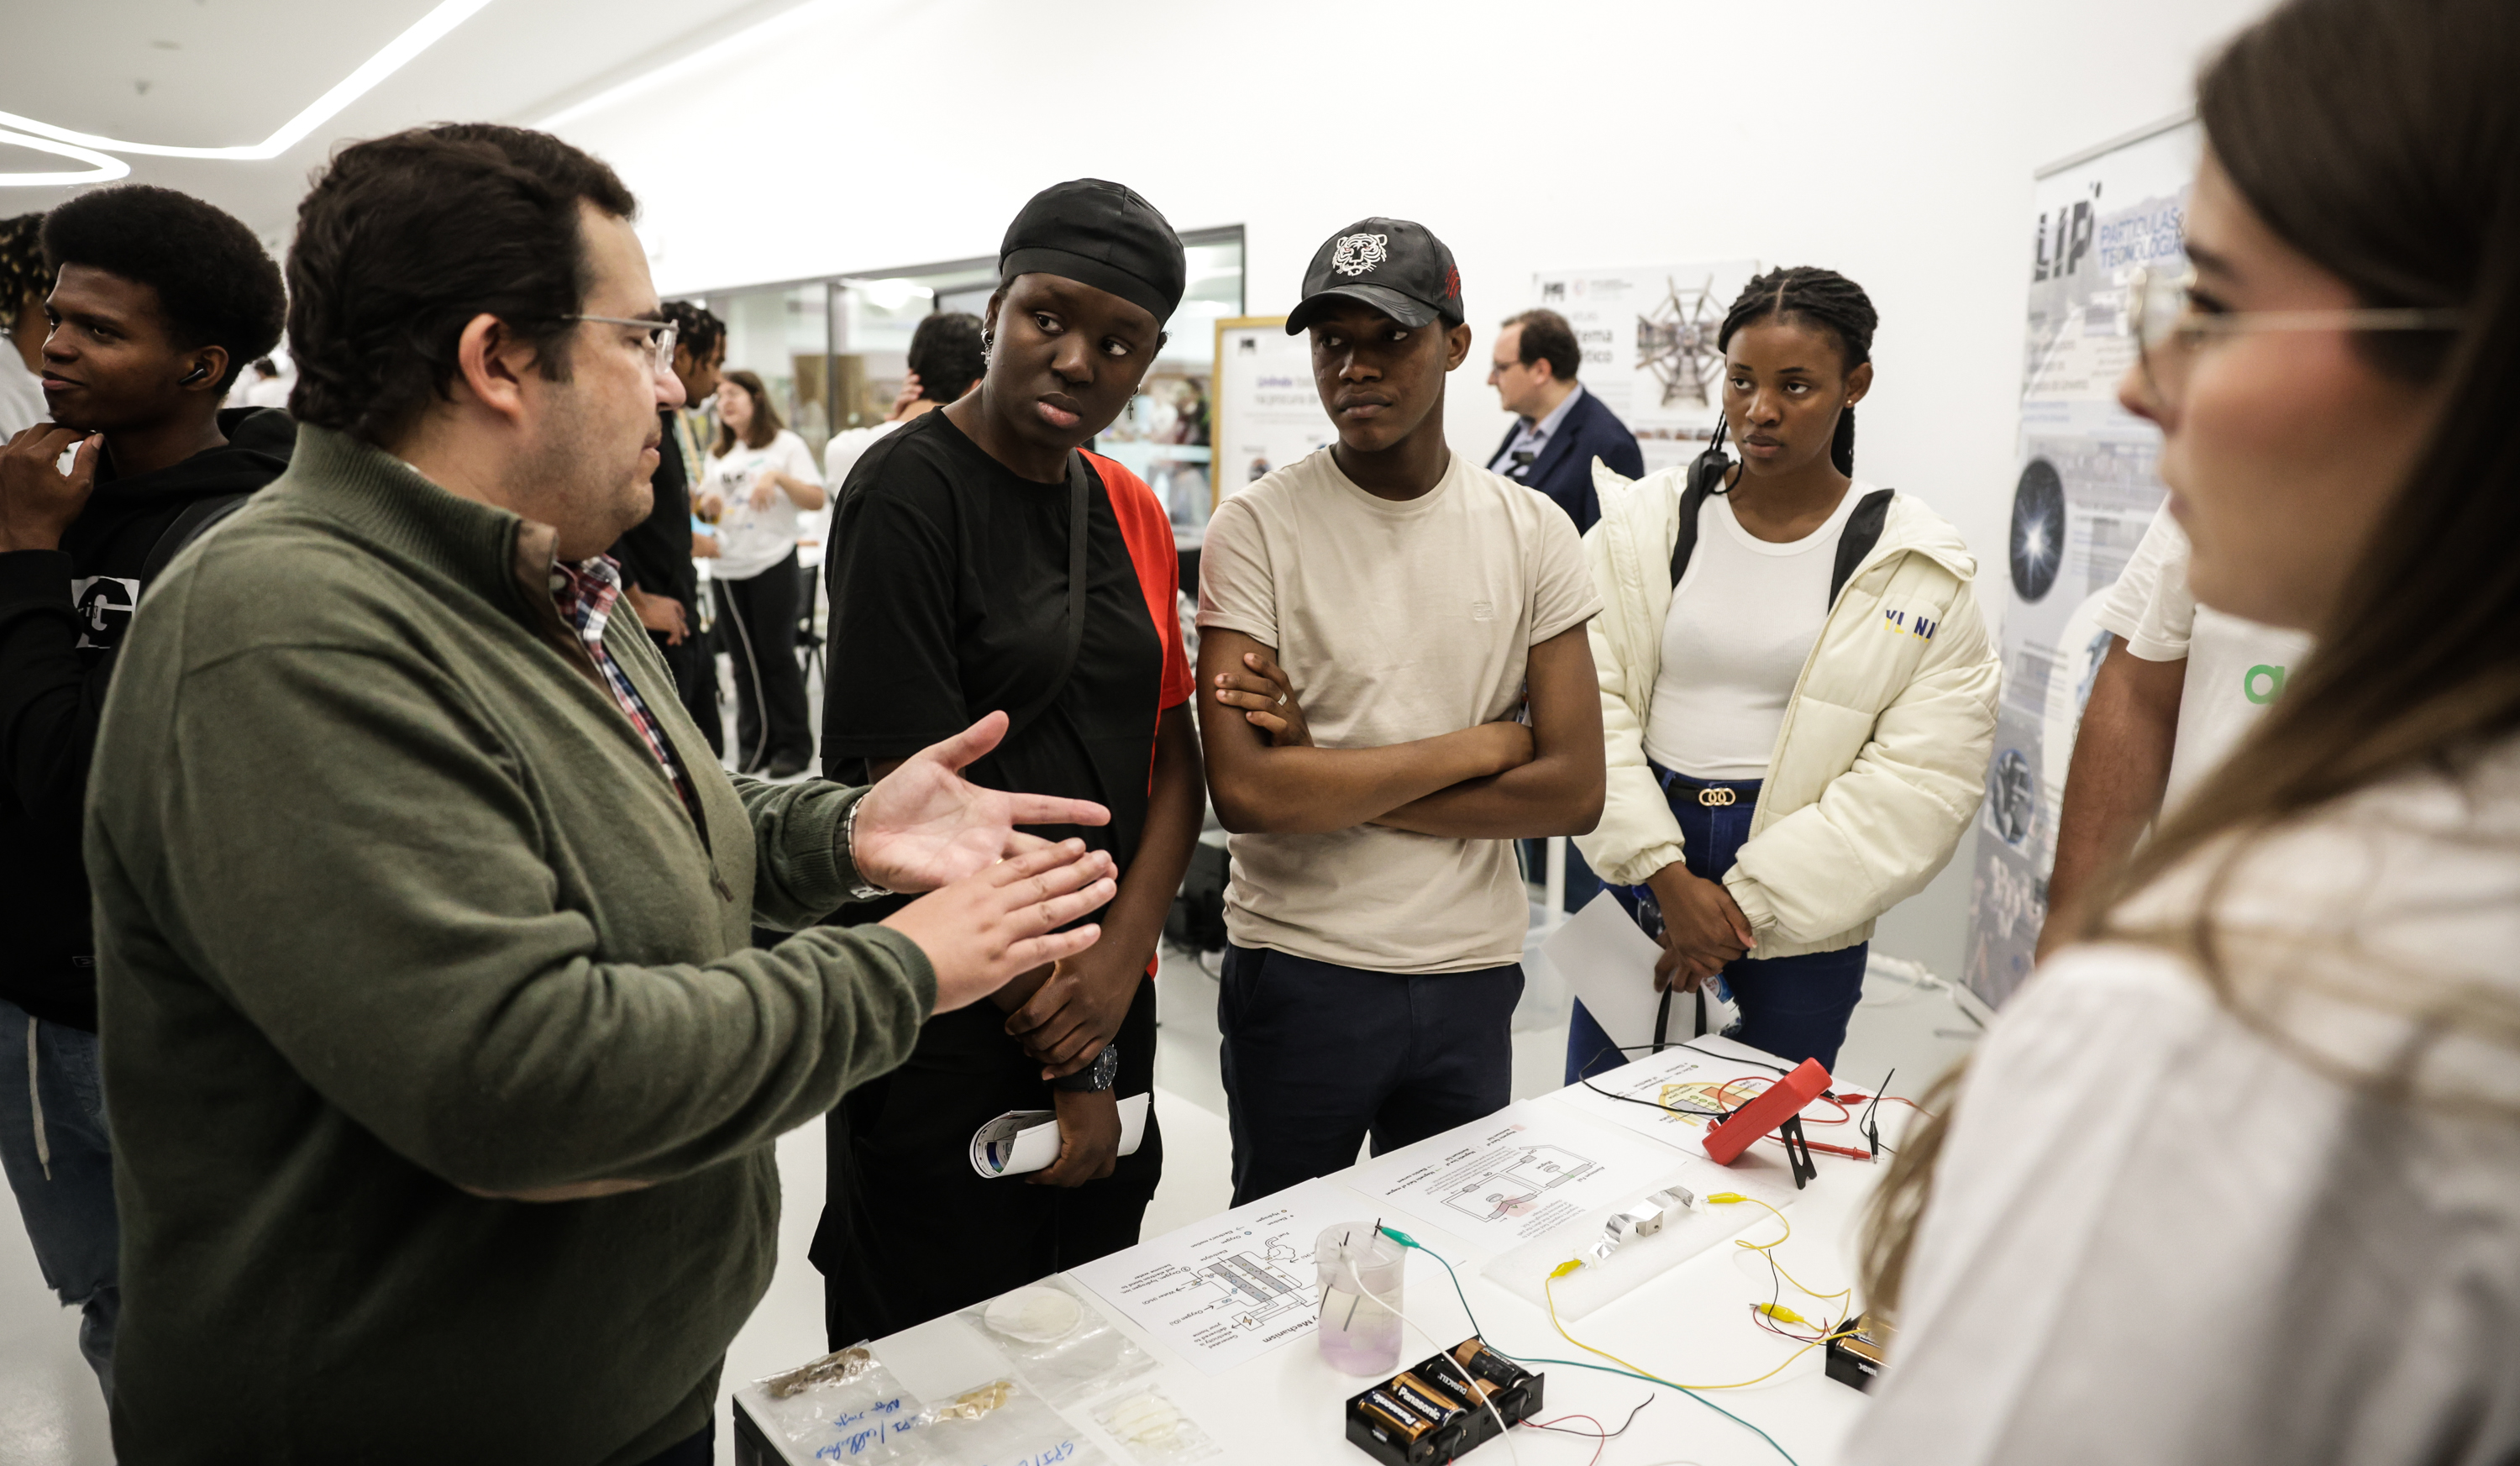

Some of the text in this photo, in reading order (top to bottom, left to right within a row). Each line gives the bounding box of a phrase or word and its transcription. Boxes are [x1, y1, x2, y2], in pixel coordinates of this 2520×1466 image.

[2034, 201, 2095, 281] LIP
[1262, 1320, 1313, 1343] Mechanism
[1439, 1372, 1468, 1395] DURACELL
[1373, 1393, 1417, 1426] Panasonic
[1398, 1385, 1441, 1421] Panasonic
